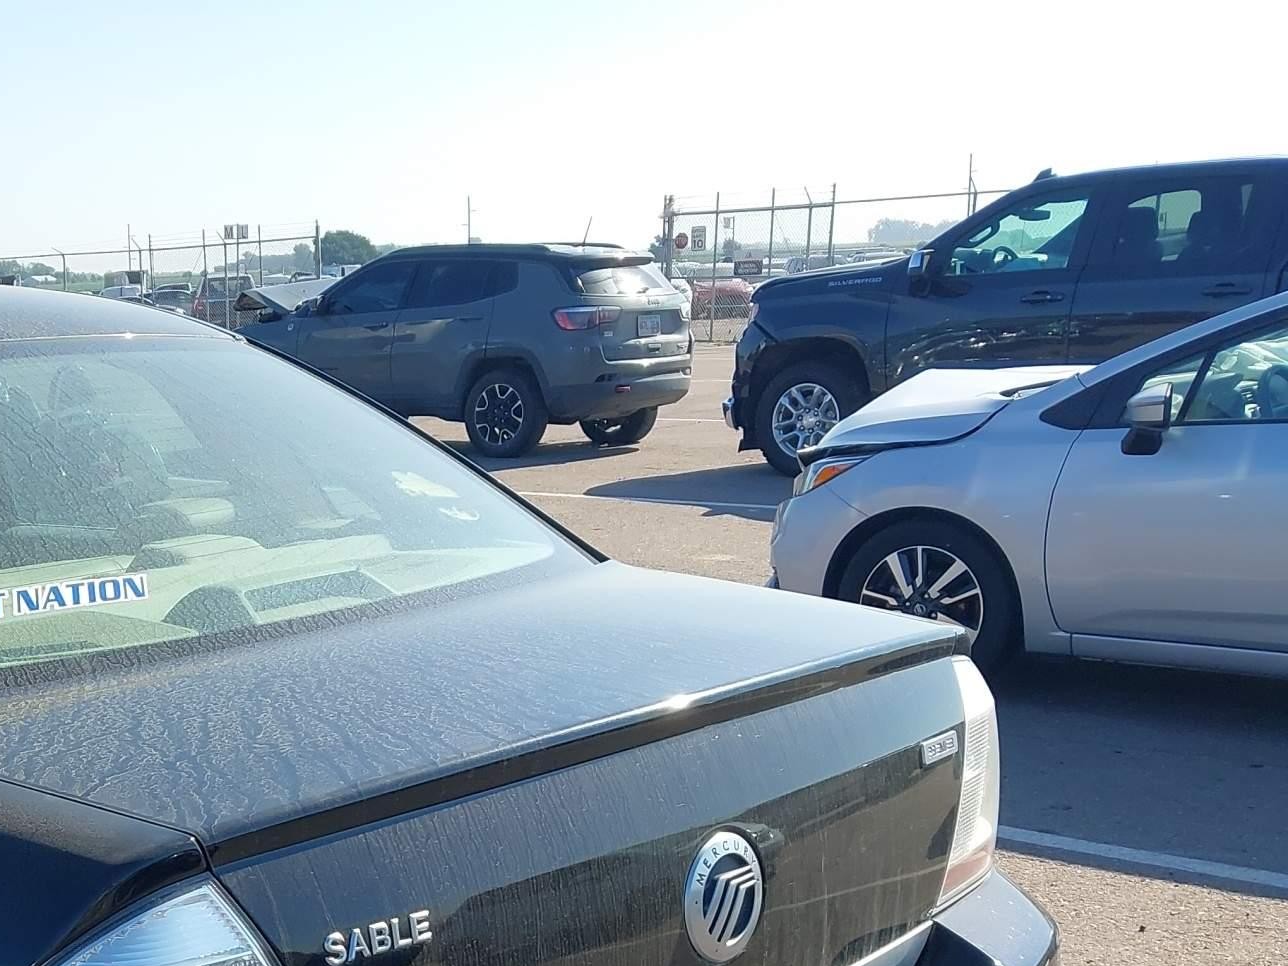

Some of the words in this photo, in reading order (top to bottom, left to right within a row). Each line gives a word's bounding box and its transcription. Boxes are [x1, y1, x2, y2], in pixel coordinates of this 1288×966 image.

[693, 239, 704, 249] 10
[16, 575, 146, 614] NATION
[695, 839, 757, 887] MERCURY
[323, 909, 433, 966] SABLE
